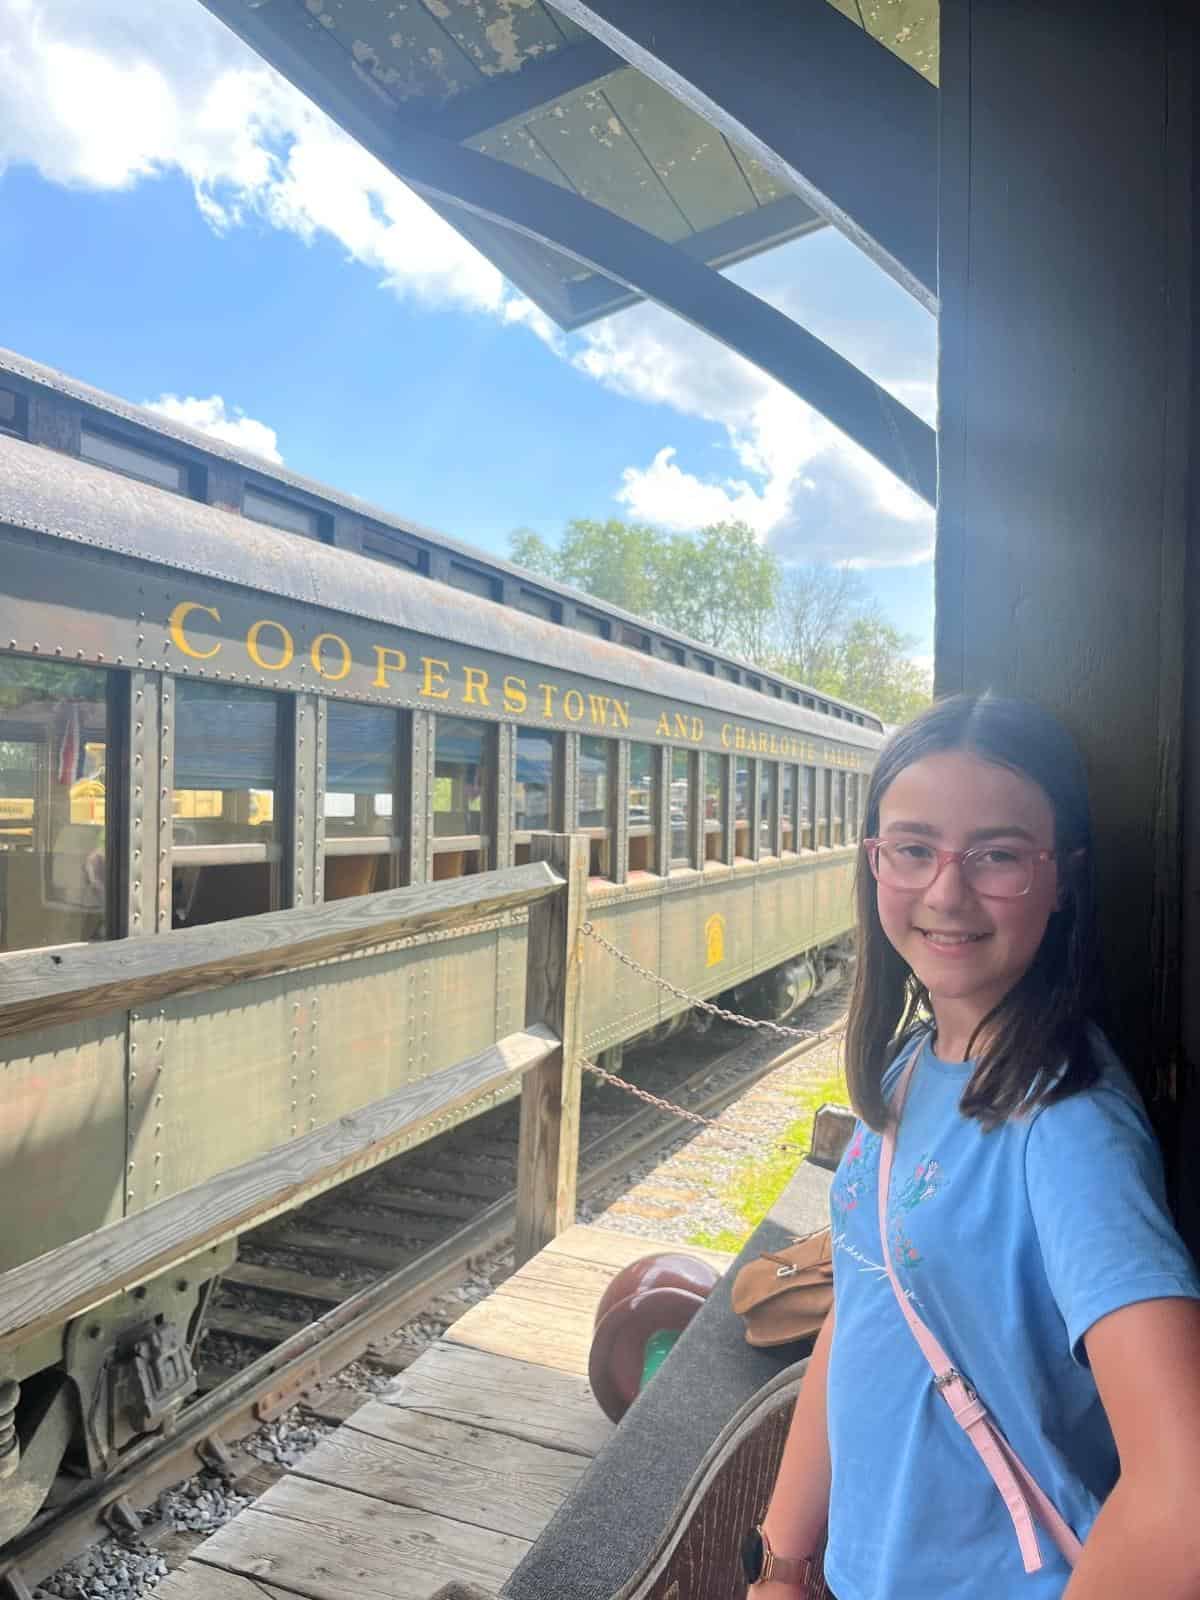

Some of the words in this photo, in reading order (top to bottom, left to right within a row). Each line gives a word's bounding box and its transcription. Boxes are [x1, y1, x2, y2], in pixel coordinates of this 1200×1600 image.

[168, 601, 631, 729] COOPERSTOWN
[655, 711, 704, 741] AND
[720, 722, 816, 760] CHARLOTTE
